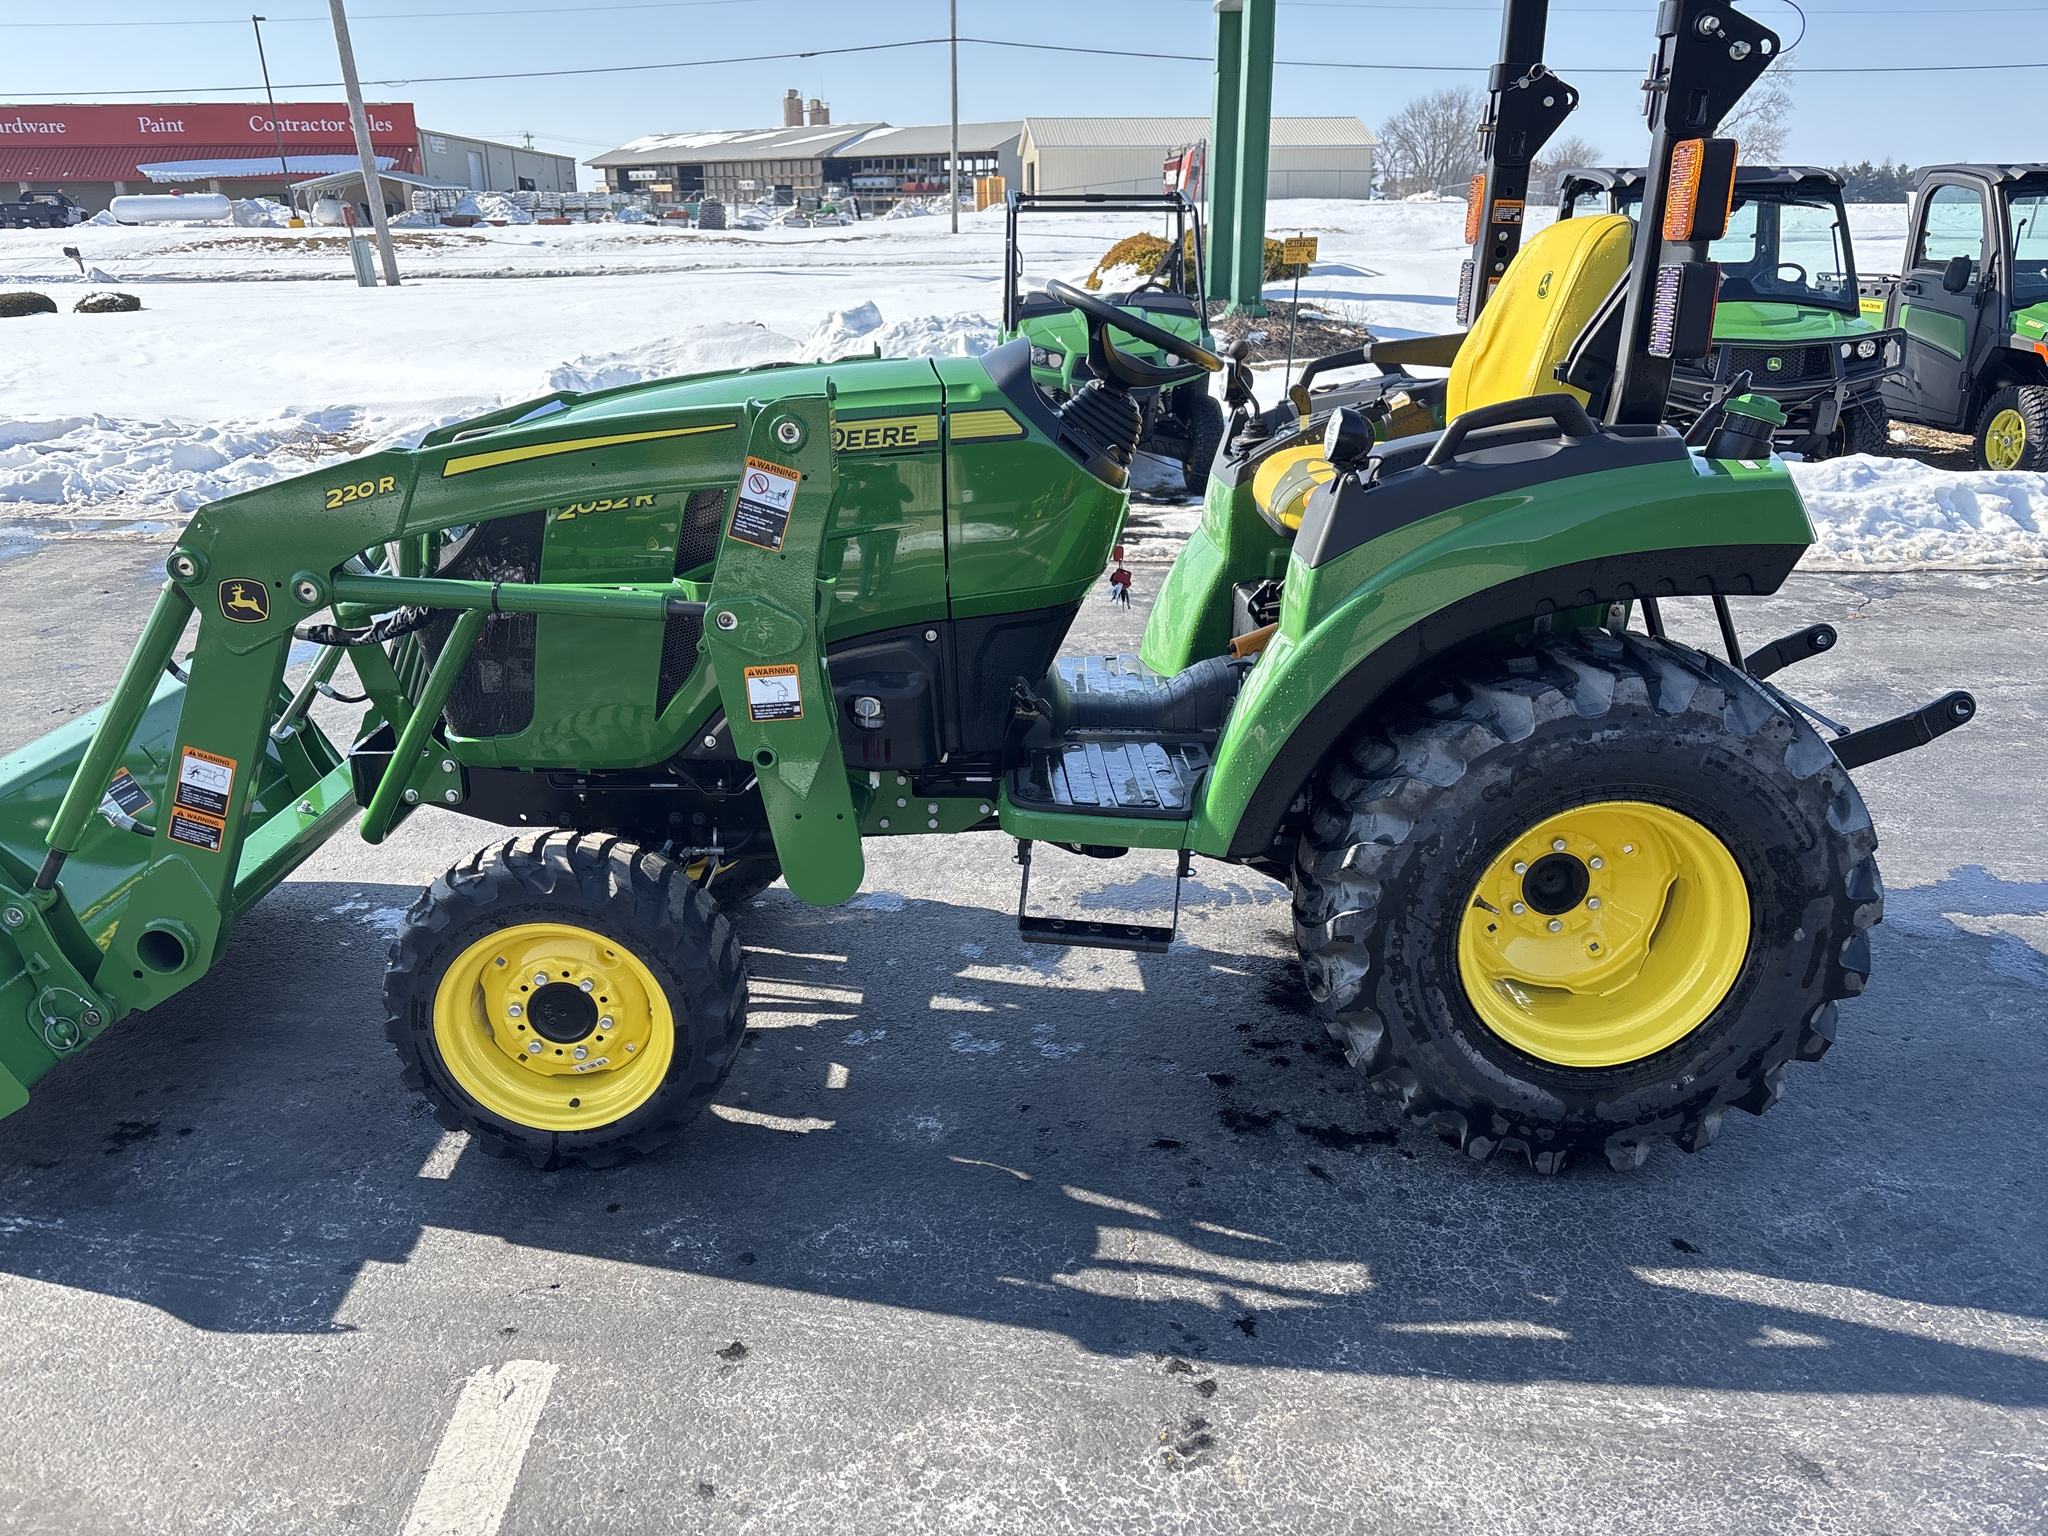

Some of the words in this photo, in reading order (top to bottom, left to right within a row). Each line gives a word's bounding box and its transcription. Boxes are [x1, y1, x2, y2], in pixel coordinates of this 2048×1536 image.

[137, 116, 185, 133] Paint
[249, 115, 345, 132] Contractor
[349, 114, 393, 132] les
[757, 460, 798, 480] WARNING
[325, 484, 376, 510] 220
[378, 475, 396, 494] R
[755, 666, 796, 676] WARNING
[197, 752, 230, 766] WARNING
[186, 812, 219, 827] WARNING
